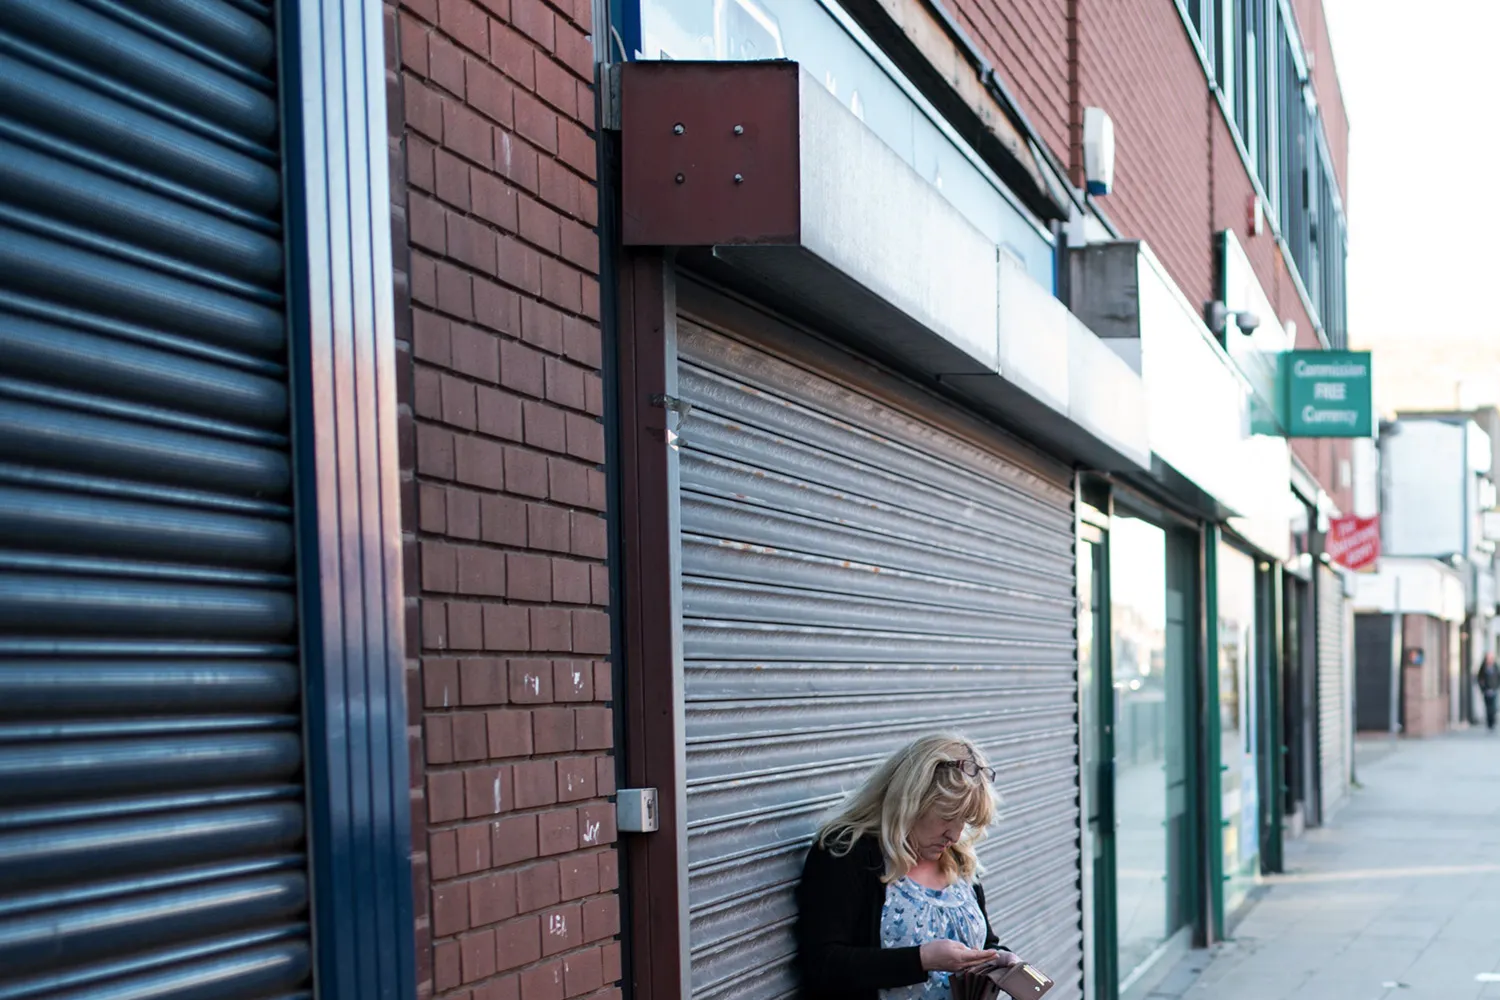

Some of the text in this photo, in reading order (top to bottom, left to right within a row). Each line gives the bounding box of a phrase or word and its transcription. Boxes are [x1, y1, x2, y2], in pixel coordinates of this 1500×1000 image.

[1294, 360, 1366, 378] Commission
[1313, 383, 1347, 401] FREE
[1302, 405, 1358, 427] Currency
